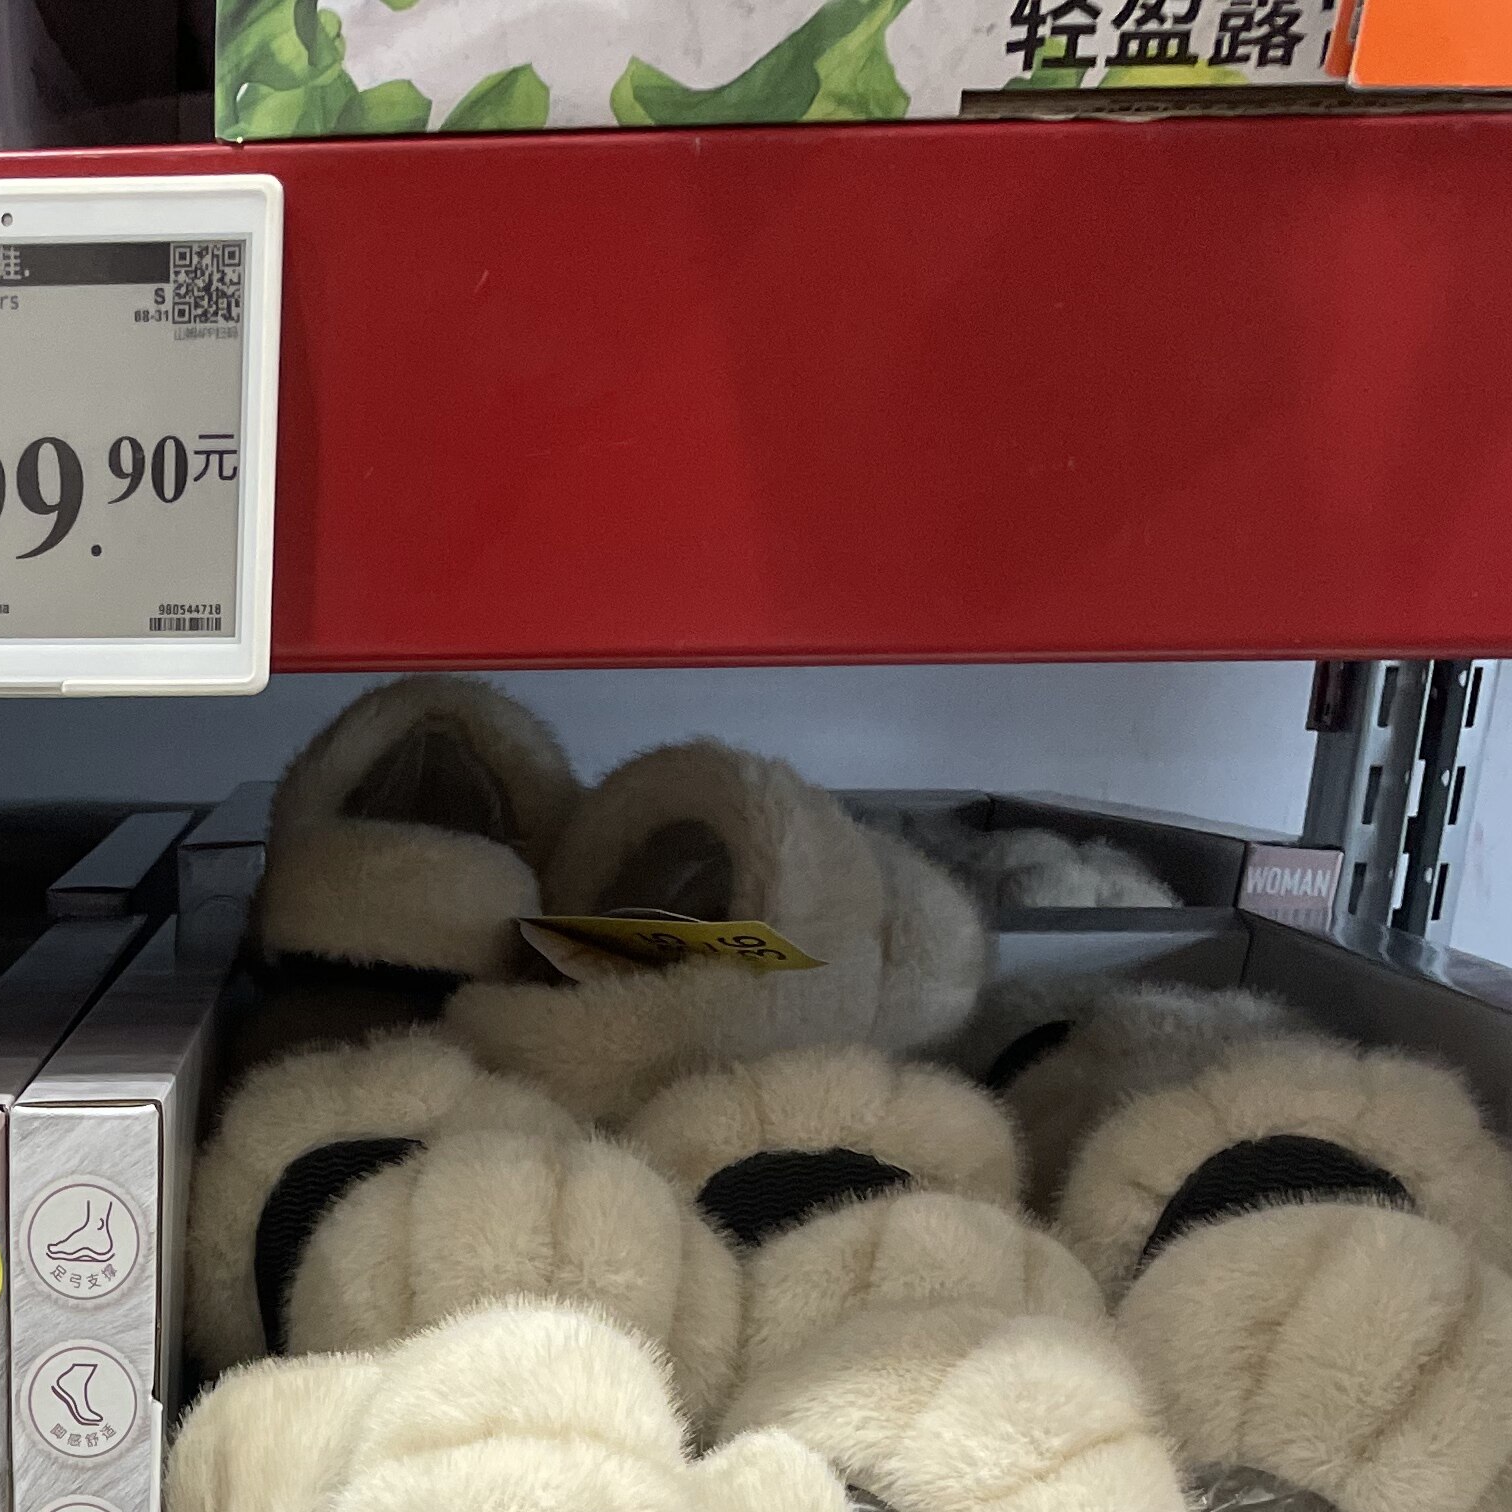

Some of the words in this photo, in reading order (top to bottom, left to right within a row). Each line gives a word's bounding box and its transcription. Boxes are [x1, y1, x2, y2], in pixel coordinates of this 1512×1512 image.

[1006, 0, 1338, 70] 轻盈露
[153, 287, 166, 306] S
[158, 603, 222, 616] 980544718
[1246, 866, 1332, 897] WOMAN
